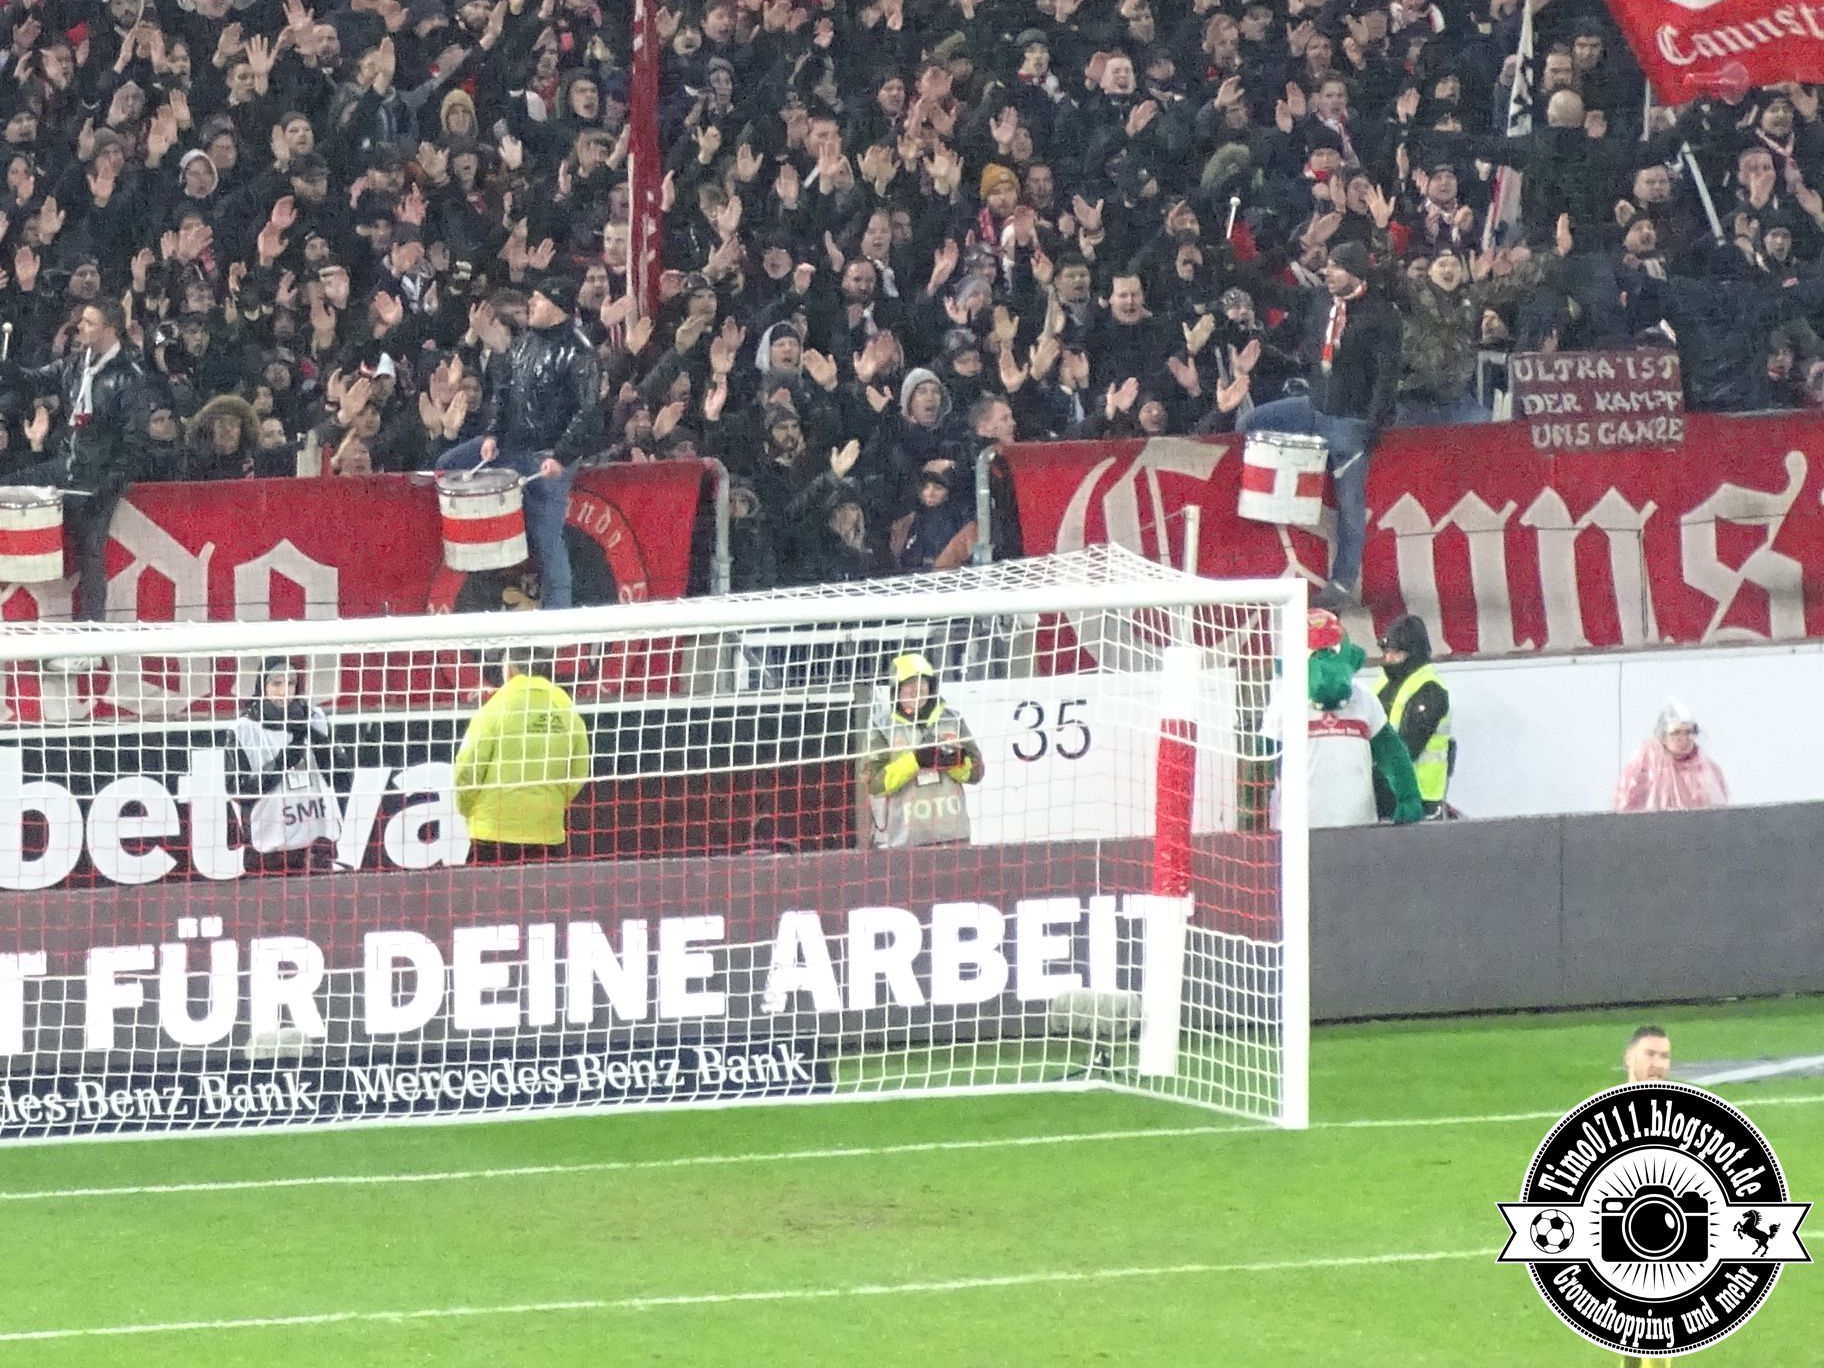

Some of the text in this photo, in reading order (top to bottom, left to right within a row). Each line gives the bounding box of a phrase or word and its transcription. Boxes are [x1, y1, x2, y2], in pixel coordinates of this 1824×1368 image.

[1656, 2, 1824, 66] Cannst
[1522, 392, 1582, 415] DER
[1013, 698, 1092, 763] 35
[86, 916, 326, 1050] FÜR
[364, 914, 725, 1034] DEINE
[197, 1073, 315, 1115] Bank
[349, 1053, 685, 1106] Mercedes-Benz
[691, 1045, 812, 1087] Bank
